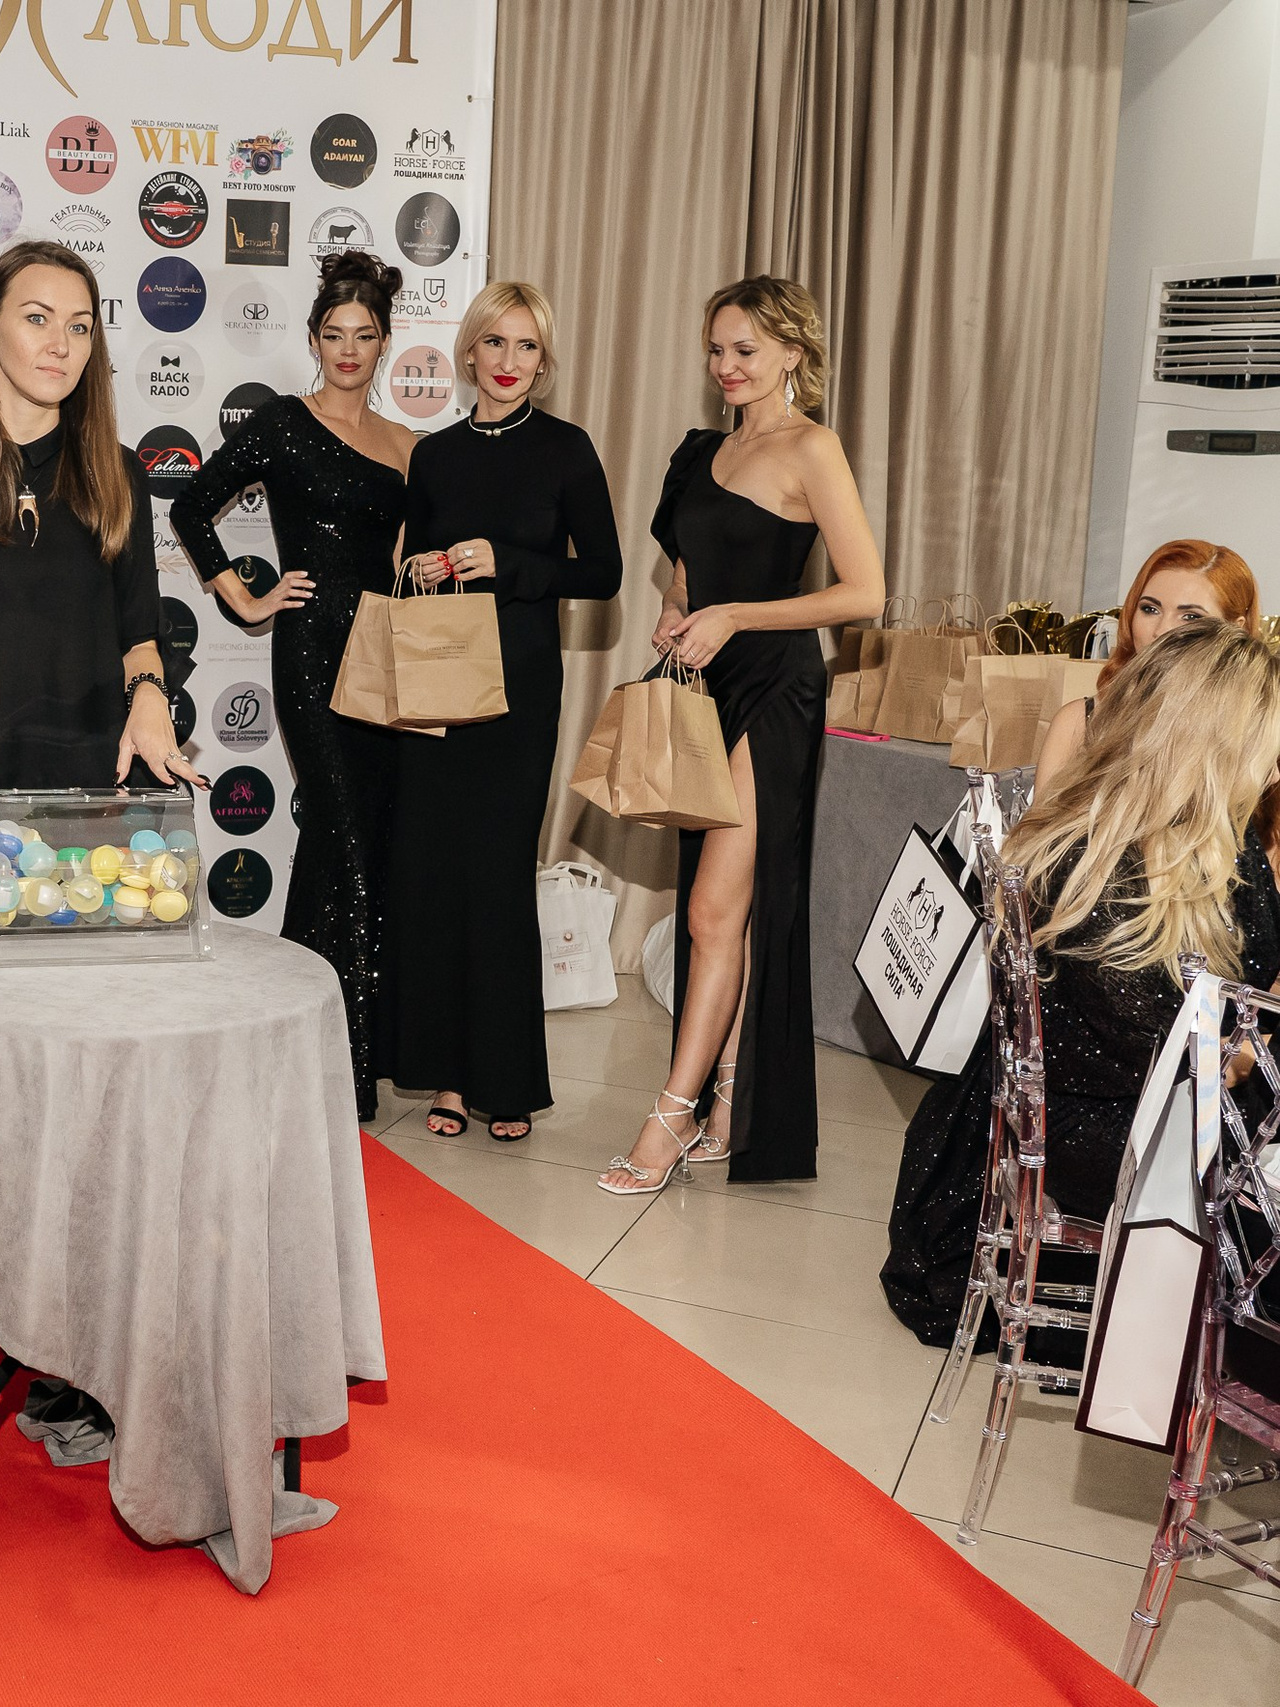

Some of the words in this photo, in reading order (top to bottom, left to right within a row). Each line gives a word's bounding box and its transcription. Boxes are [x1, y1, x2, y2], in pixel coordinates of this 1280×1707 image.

[132, 119, 155, 128] WORLD
[157, 121, 184, 129] FASHION
[186, 122, 219, 131] MAGAZINE
[131, 126, 219, 166] WFM
[332, 138, 357, 148] GOAR
[57, 151, 90, 159] BEAUTY
[92, 152, 113, 161] LOFT
[324, 152, 365, 162] ADAMYAN
[394, 170, 442, 180] ЛОШАДИНАЯ
[444, 172, 466, 181] СИЛА
[222, 182, 242, 191] BEST
[243, 182, 262, 192] FOTO
[263, 183, 296, 193] MOSCOW
[50, 205, 112, 227] ТЕАТРАЛЬНАЯ
[225, 321, 253, 330] SERGIO
[256, 322, 287, 332] DALLINI
[150, 372, 190, 383] BLACK
[400, 378, 429, 386] BEAUTY
[150, 385, 190, 397] RADIO
[208, 643, 242, 651] PIERCING
[215, 808, 268, 817] AFROPAUK
[881, 926, 924, 1000] ЛОШАДИНАЯ
